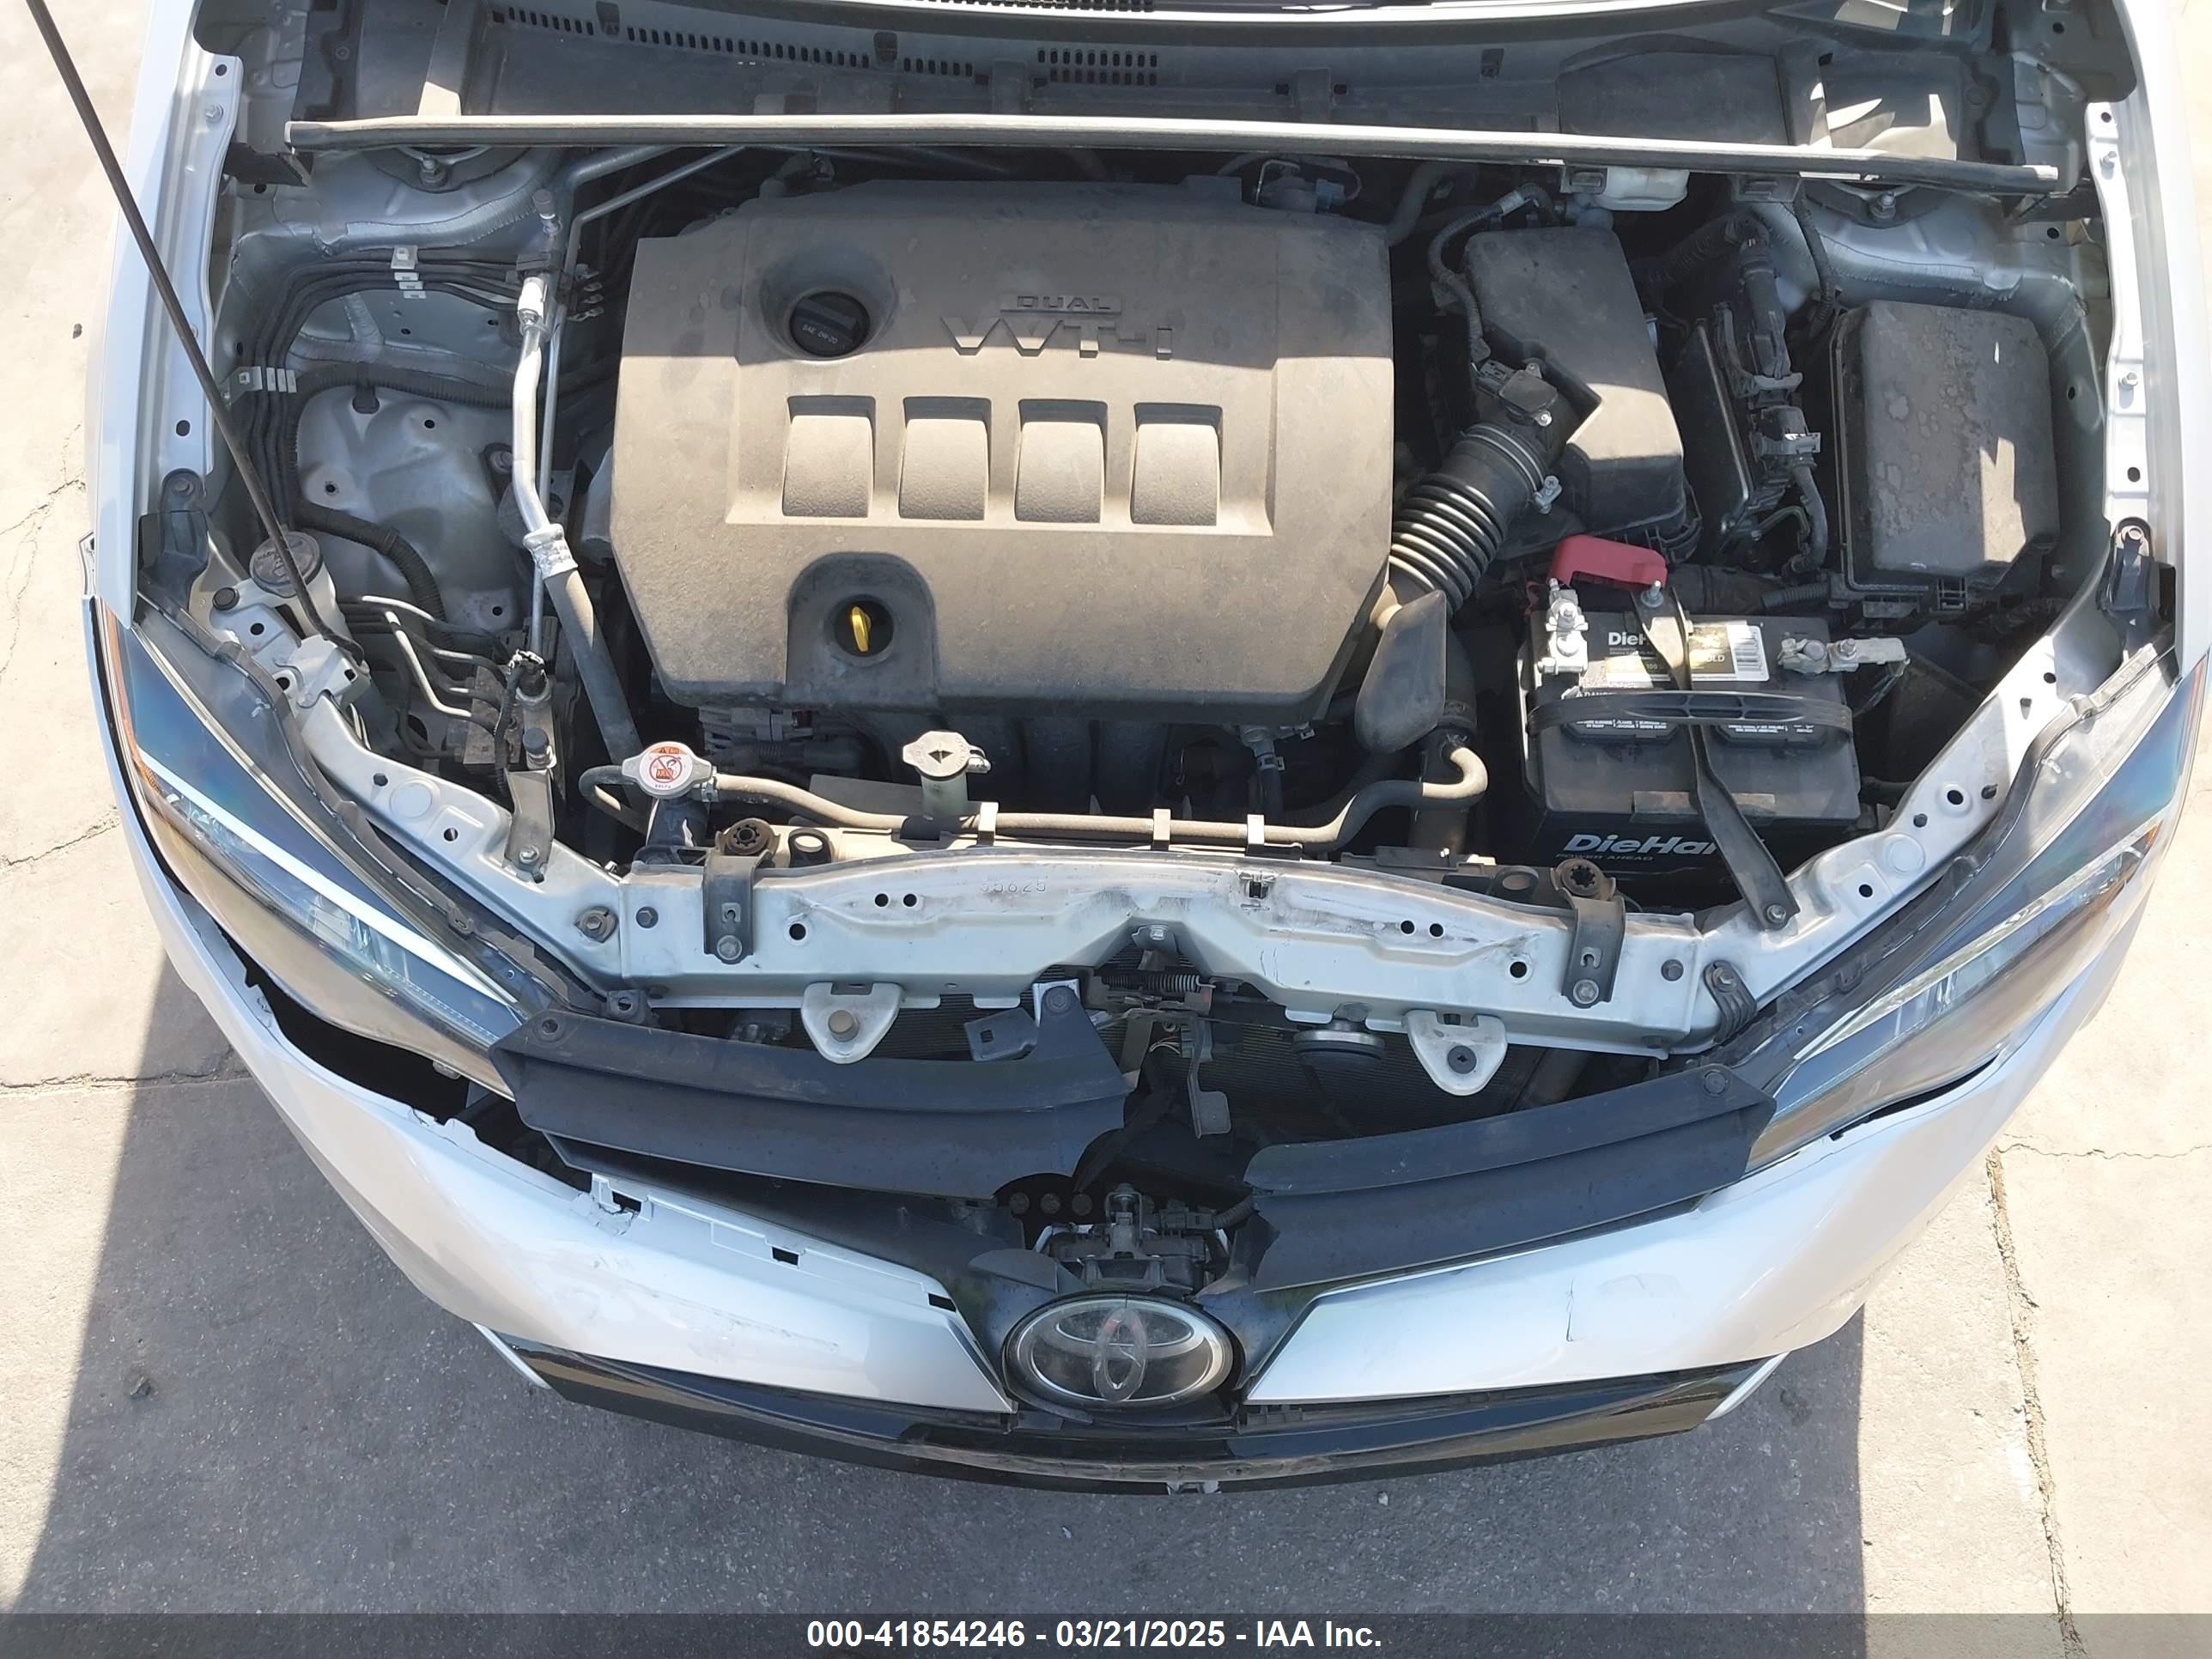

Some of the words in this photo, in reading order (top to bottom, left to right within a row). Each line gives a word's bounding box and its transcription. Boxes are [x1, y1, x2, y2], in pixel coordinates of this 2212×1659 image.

[1017, 295, 1111, 309] DUAL
[1608, 632, 1646, 646] DieH
[1564, 834, 1717, 855] DieHar
